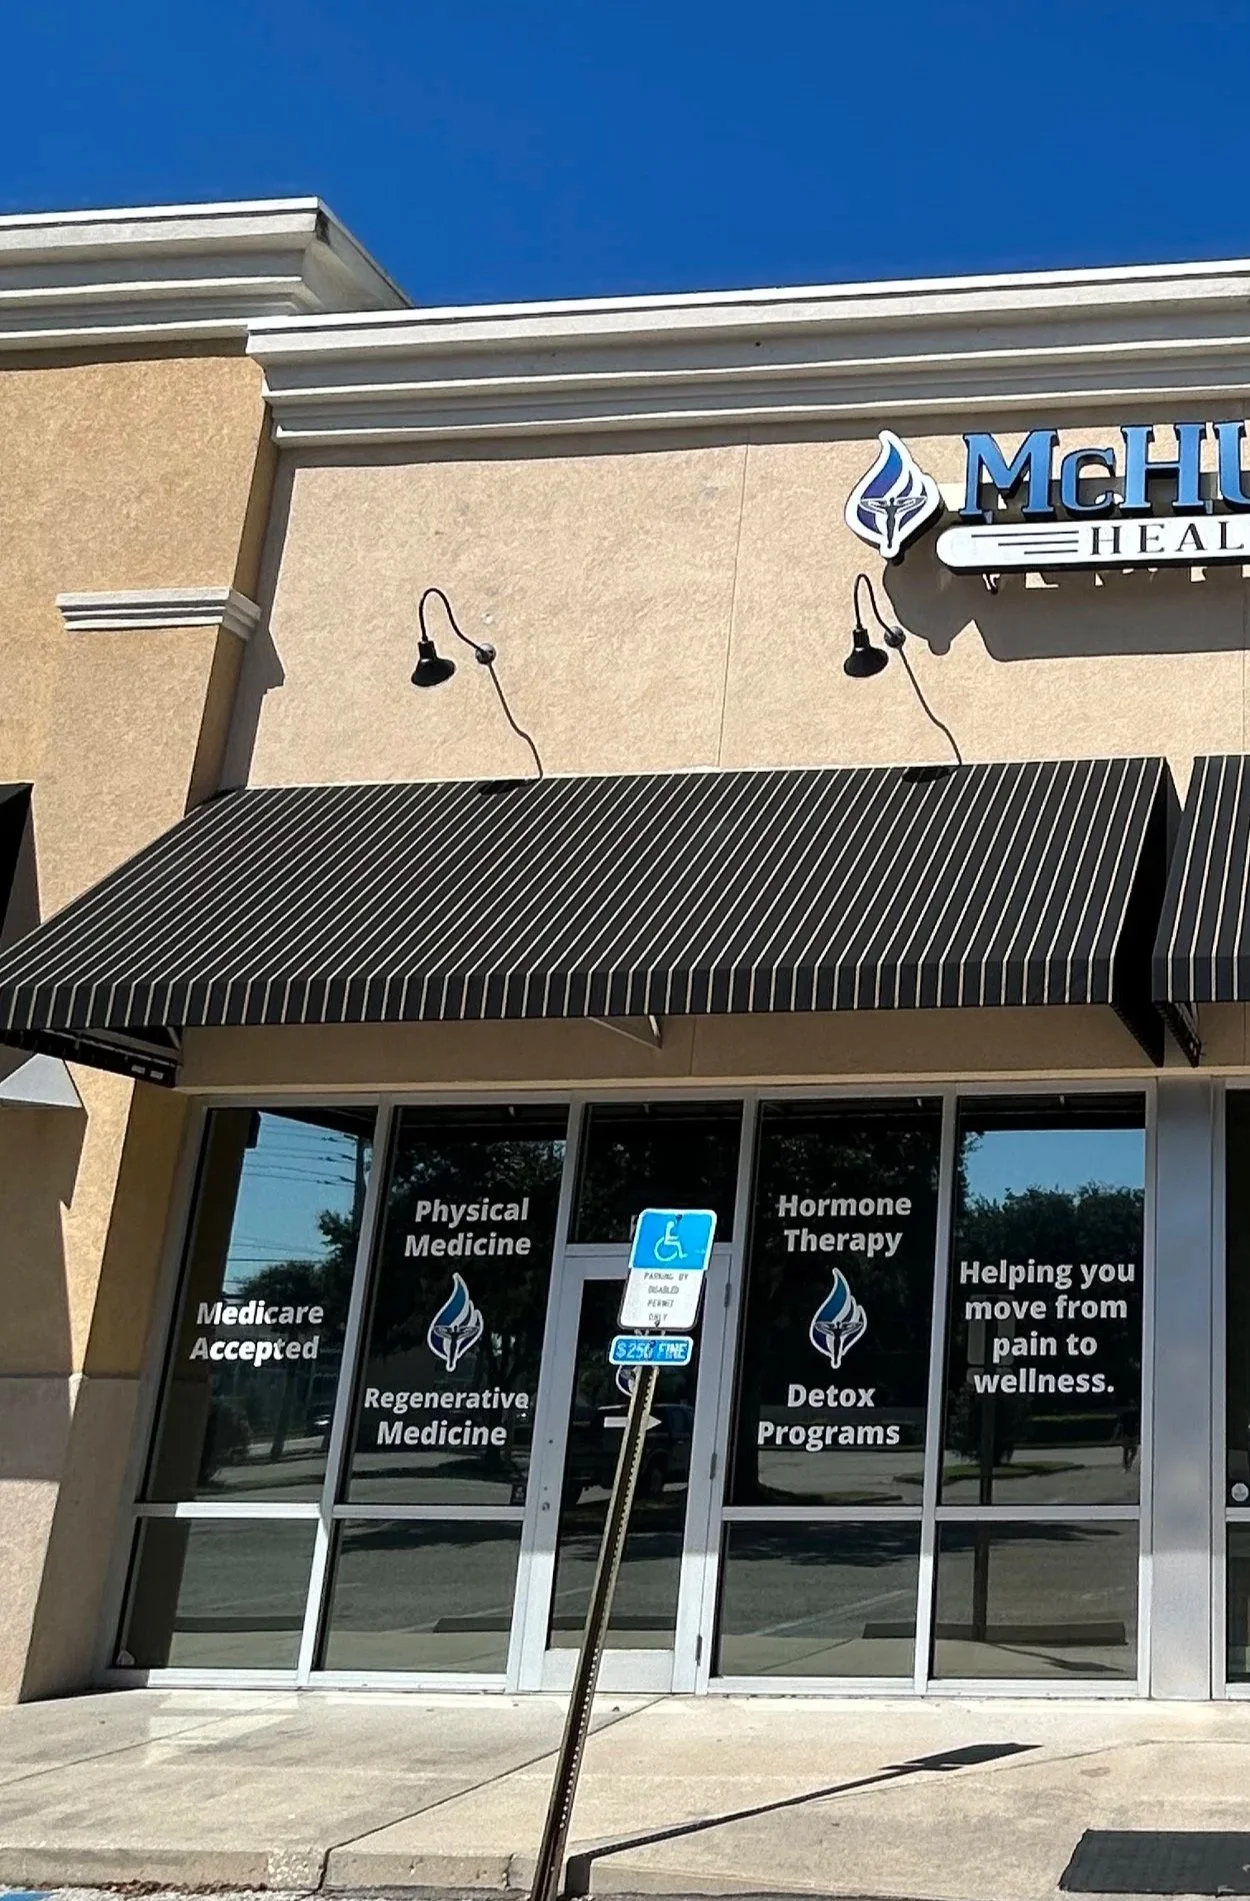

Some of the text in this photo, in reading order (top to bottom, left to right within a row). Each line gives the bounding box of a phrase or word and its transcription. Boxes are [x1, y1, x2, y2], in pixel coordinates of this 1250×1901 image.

[415, 1197, 529, 1229] Physical
[778, 1193, 912, 1218] Hormone
[404, 1233, 532, 1258] Medicine
[784, 1228, 903, 1258] Therapy
[960, 1259, 1136, 1290] Helping you
[196, 1300, 324, 1326] Medicare
[647, 1298, 674, 1308] PERMIT
[965, 1294, 1129, 1320] move from
[189, 1336, 319, 1368] Accepted
[658, 1342, 688, 1360] FINE
[993, 1331, 1098, 1364] pain to
[973, 1368, 1115, 1394] wellness.
[364, 1387, 530, 1414] Regenerative
[788, 1384, 876, 1409] Detox
[376, 1420, 508, 1447] Medicine
[757, 1421, 901, 1453] Programs
